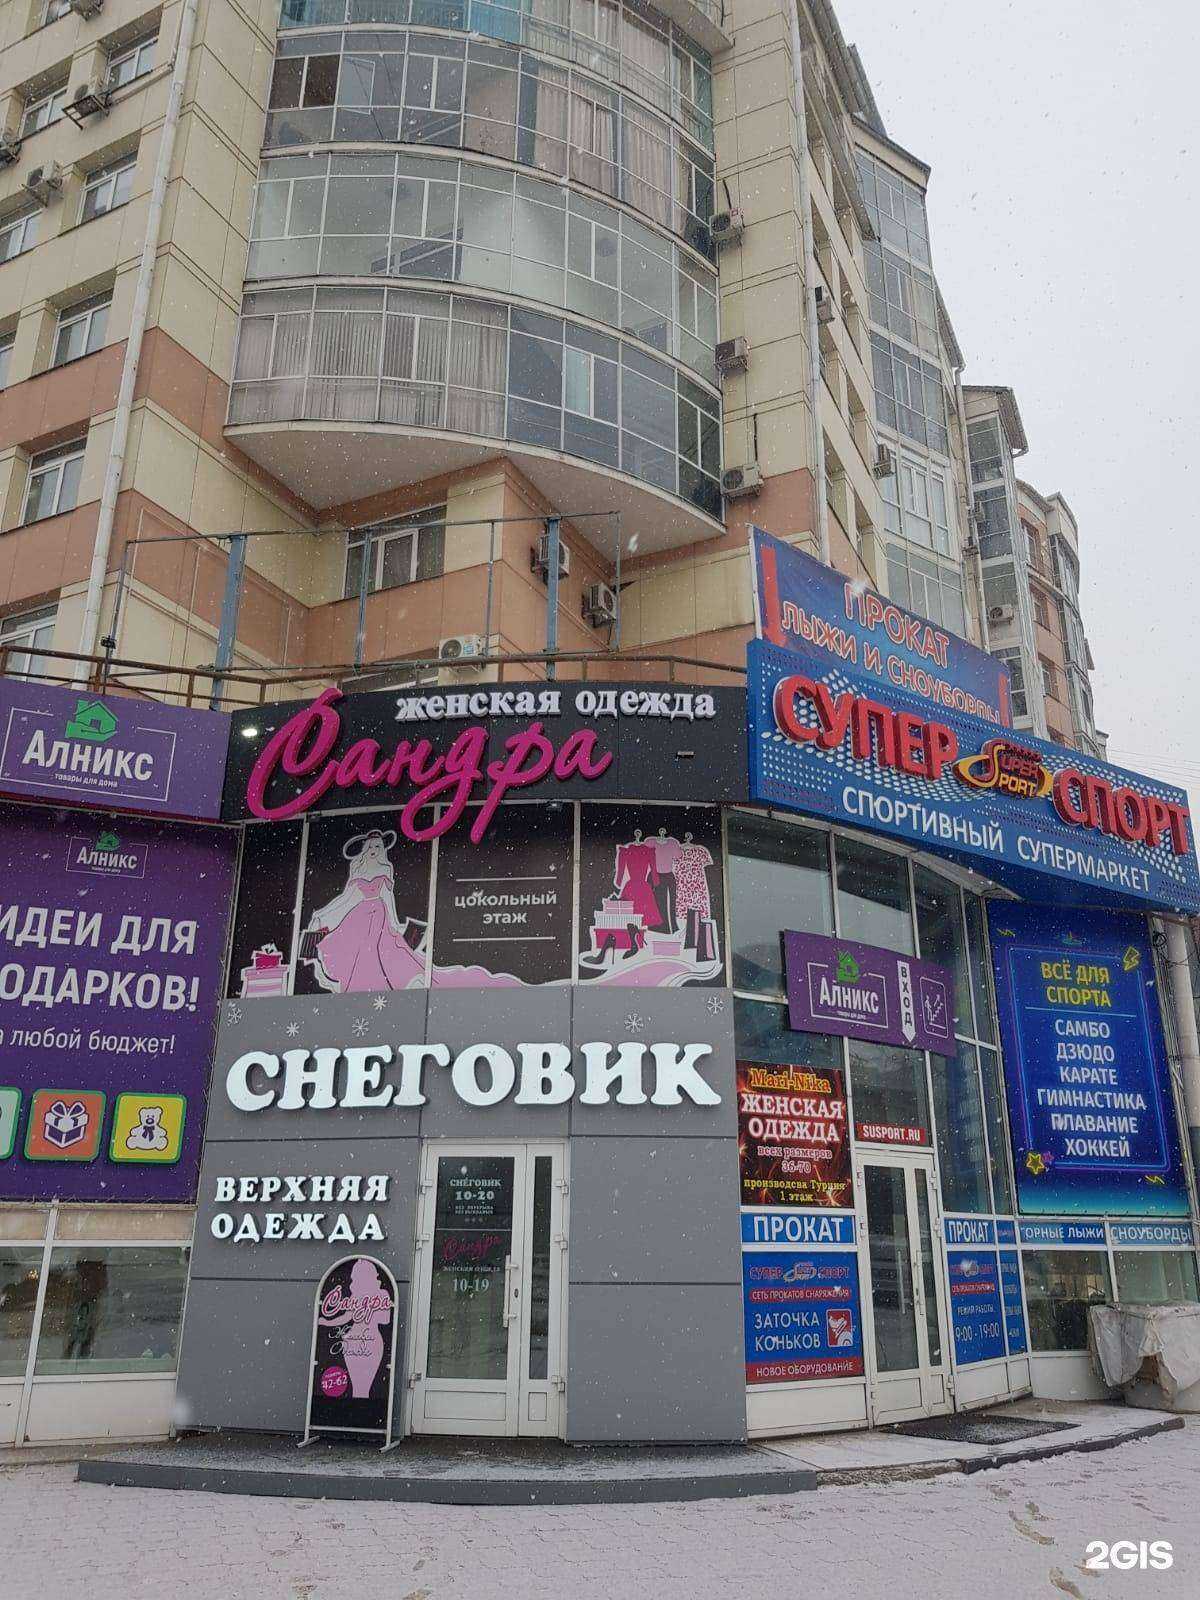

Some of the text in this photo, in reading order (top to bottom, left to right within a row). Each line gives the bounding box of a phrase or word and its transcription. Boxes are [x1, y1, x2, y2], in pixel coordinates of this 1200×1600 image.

[844, 582, 950, 669] ПРОКАТ
[782, 601, 857, 664] ЛЫЖИ
[864, 642, 883, 676] И
[395, 690, 716, 722] женская одежда
[773, 674, 959, 780] СУПЕР
[246, 687, 612, 843] Сандра
[1052, 767, 1190, 856] СПОРТ
[843, 786, 1150, 892] СПОРТИВНЫЙ СУПЕРМАРКЕТ
[455, 889, 557, 908] цокольный
[483, 912, 527, 924] этаж
[0, 904, 198, 956] ИДЕИ ДЛЯ
[1040, 959, 1110, 985] ВСЁ ДЛЯ
[900, 966, 913, 1027] ВХОД
[1046, 985, 1112, 1008] СПОРТА
[1055, 1018, 1110, 1039] САМБО
[10, 1027, 81, 1049] любой
[89, 1030, 176, 1054] бюджет!
[1056, 1042, 1115, 1063] ДЗЮДО
[226, 1042, 721, 1111] СНЕГОВИК
[750, 1067, 831, 1093] Mari-Nika
[1059, 1066, 1118, 1086] КАРАТЕ
[741, 1093, 843, 1119] ЖЕНСКАЯ
[1037, 1088, 1145, 1111] ГИМНАСТИКА
[748, 1117, 840, 1144] ОДЕЖДА
[862, 1125, 921, 1142] SUSPORT.RU
[1051, 1112, 1138, 1134] ПЛАВАНИЕ
[757, 1146, 832, 1160] всех размеров
[1064, 1137, 1130, 1158] ХОККЕЙ
[781, 1161, 812, 1174] 36-70
[215, 1175, 389, 1203] ВЕРХНЯЯ
[456, 1190, 495, 1200] 10-20
[788, 1192, 813, 1202] этаж
[210, 1212, 386, 1243] ОДЕЖДА
[753, 1215, 844, 1242] ПРОКАТ
[948, 1221, 989, 1243] ПРОКАТ
[1068, 1227, 1104, 1239] ЛЫЖИ
[1111, 1226, 1192, 1243] СНОУБОРДЫ
[453, 1278, 489, 1292] 10-19
[752, 1291, 768, 1300] СЕТЬ
[770, 1290, 804, 1299] ПРОКАТОВ
[321, 1285, 391, 1324] Сандра
[754, 1311, 820, 1329] ЗАТОЧКА
[755, 1333, 821, 1351] КОНЬКОВ
[955, 1326, 973, 1342] 9:00
[979, 1323, 999, 1340] 19:00
[756, 1362, 853, 1377] НОВОЕ ОБОРУДОВАНИЕ
